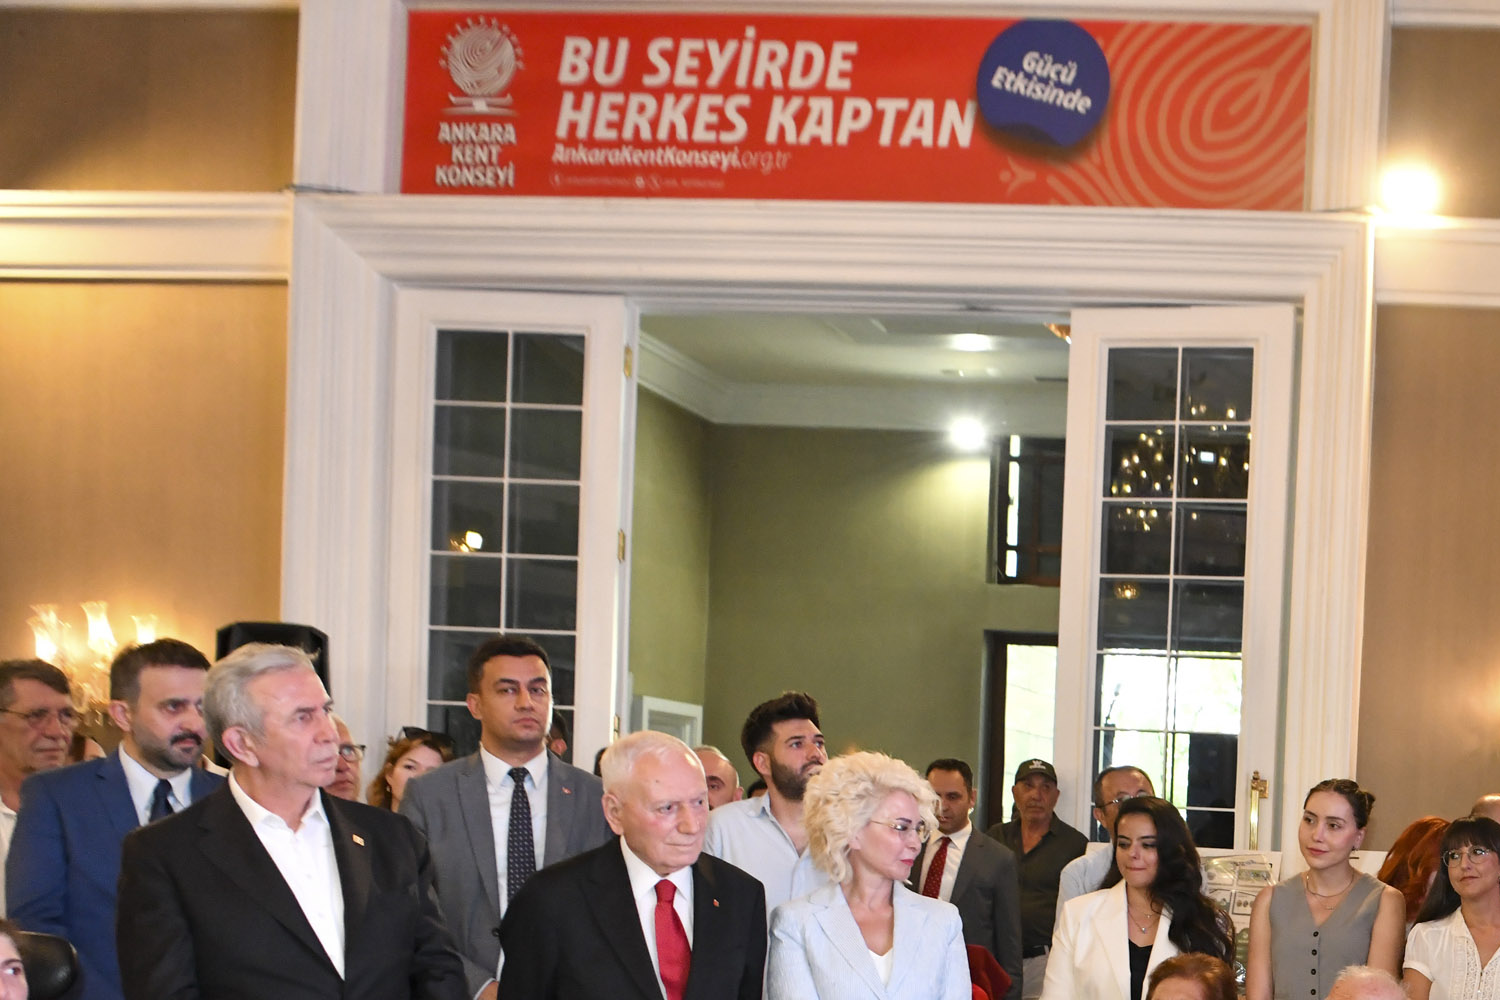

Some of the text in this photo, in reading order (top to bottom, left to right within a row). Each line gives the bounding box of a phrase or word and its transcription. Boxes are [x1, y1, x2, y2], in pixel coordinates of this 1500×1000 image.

[558, 26, 858, 90] BU SEYİRDE
[1022, 51, 1078, 86] Gücü
[991, 65, 1092, 115] Etkisinde
[438, 121, 517, 145] ANKARA
[556, 91, 976, 148] HERKES KAPTAN
[452, 143, 502, 165] KENT
[436, 161, 514, 188] KONSEYİ
